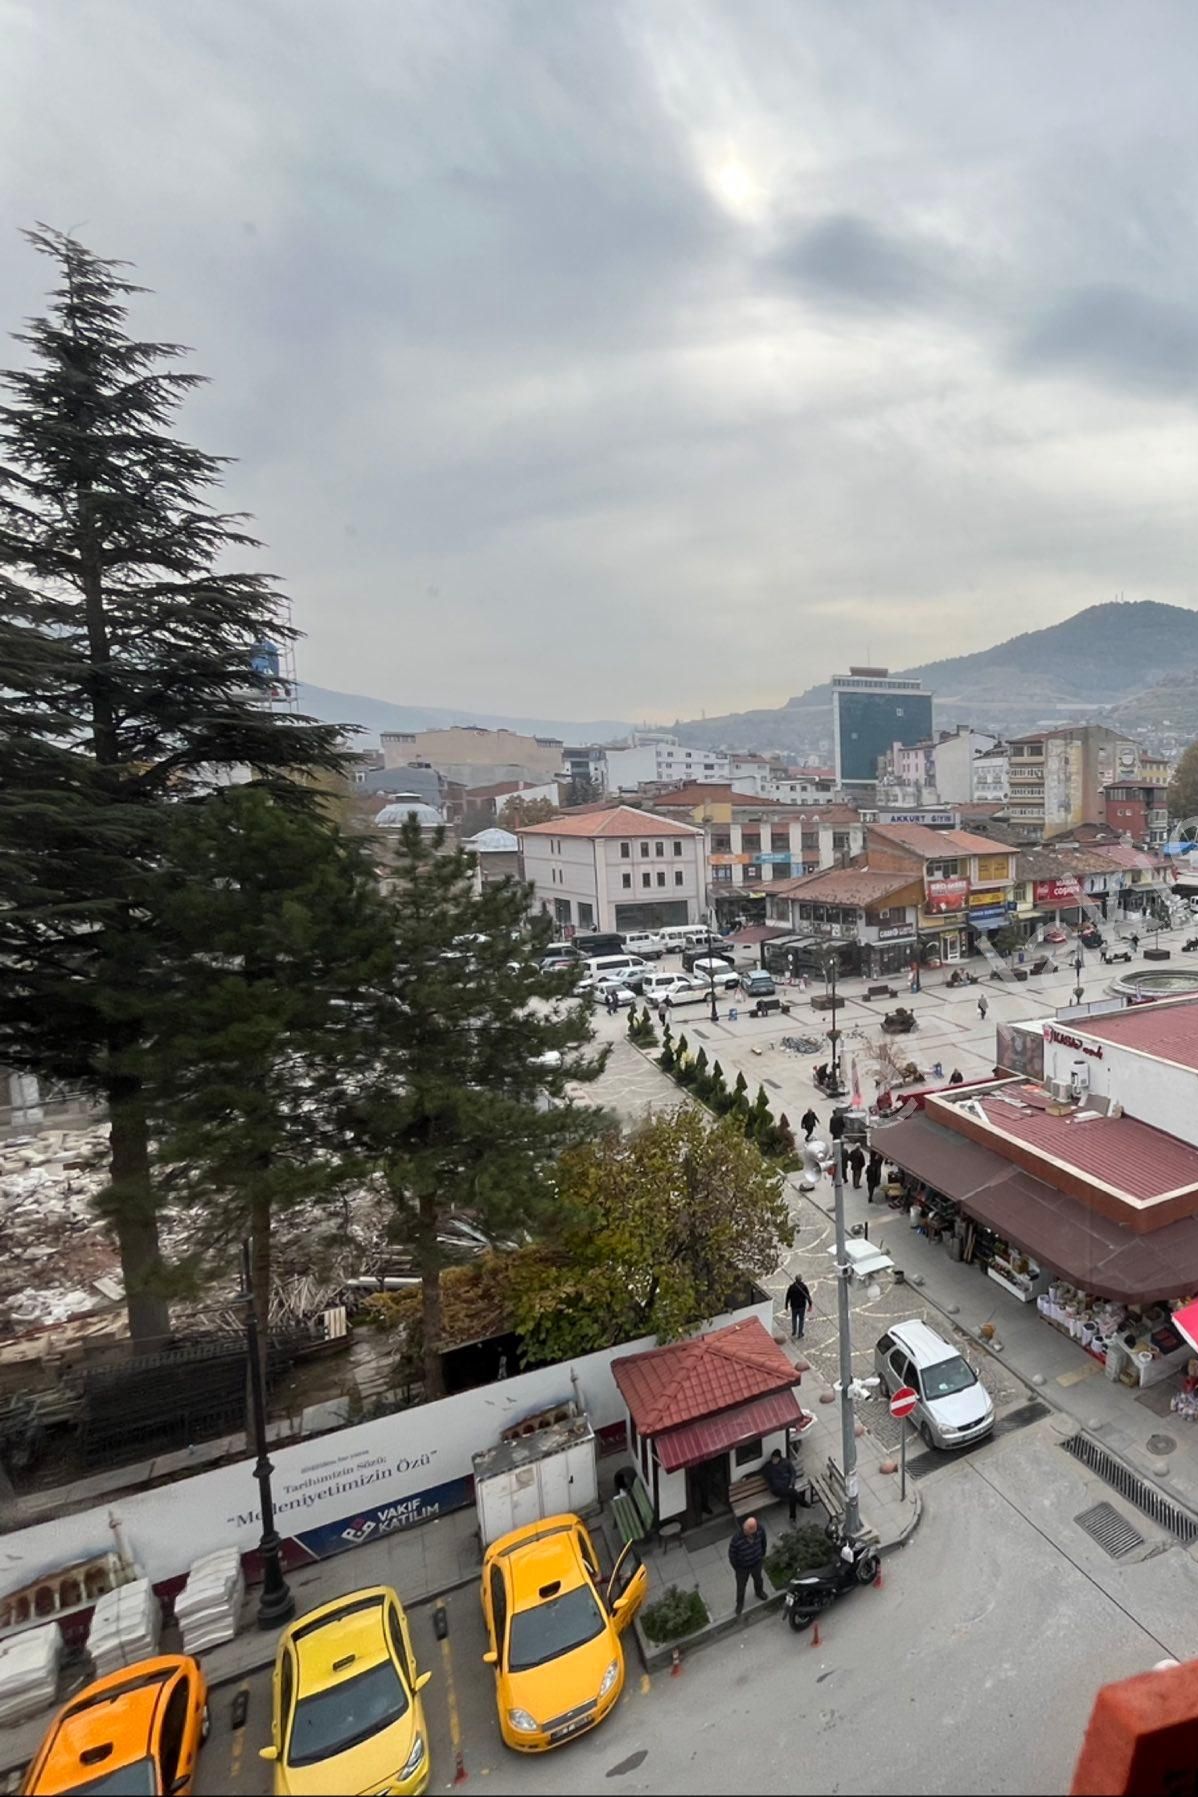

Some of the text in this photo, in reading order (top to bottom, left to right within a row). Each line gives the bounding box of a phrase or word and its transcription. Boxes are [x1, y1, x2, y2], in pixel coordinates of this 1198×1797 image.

[283, 1466, 354, 1494] Tarihimizin
[377, 1498, 421, 1522] VAKIF
[378, 1502, 440, 1532] KATILIM
